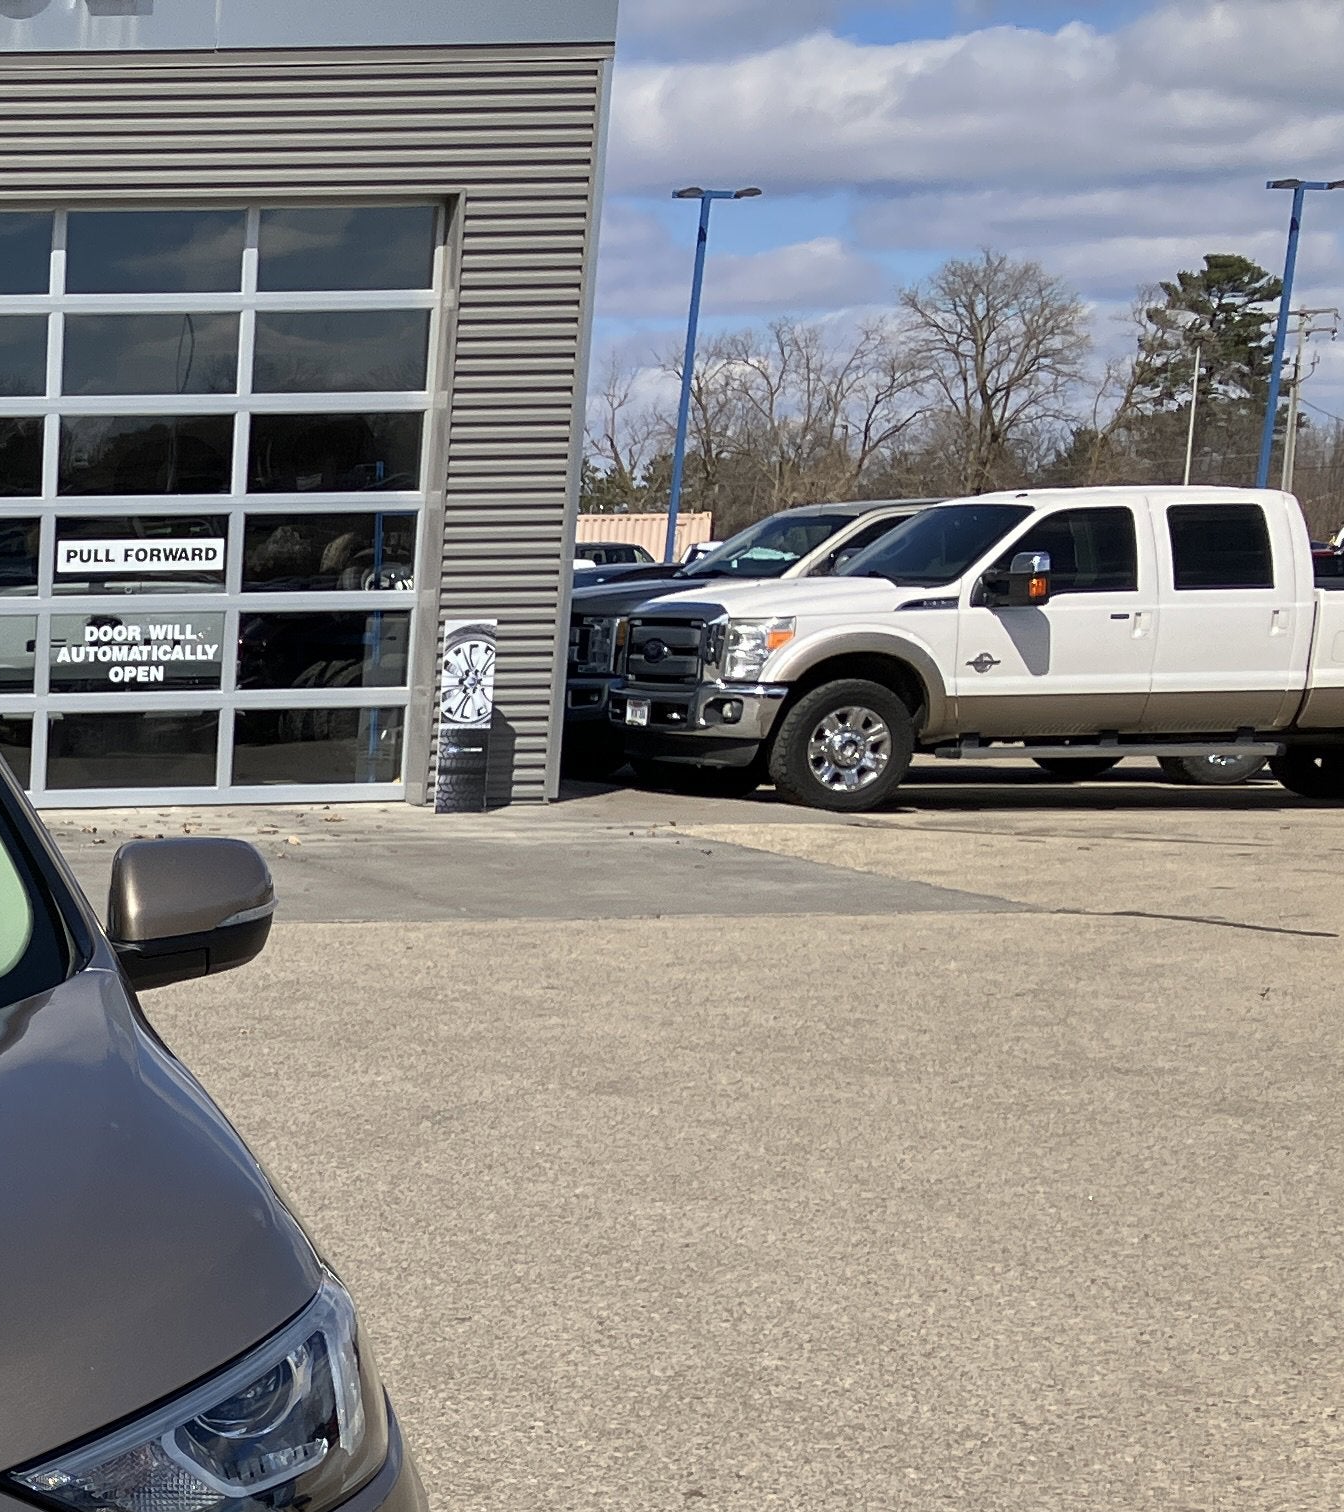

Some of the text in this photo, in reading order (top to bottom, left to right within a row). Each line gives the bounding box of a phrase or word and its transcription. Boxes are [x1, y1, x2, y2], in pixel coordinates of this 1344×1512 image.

[66, 547, 217, 563] PULL FORWARD
[84, 624, 197, 642] DOOR WILL
[56, 644, 219, 663] AUTOMATICALLY
[108, 666, 164, 682] OPEN
